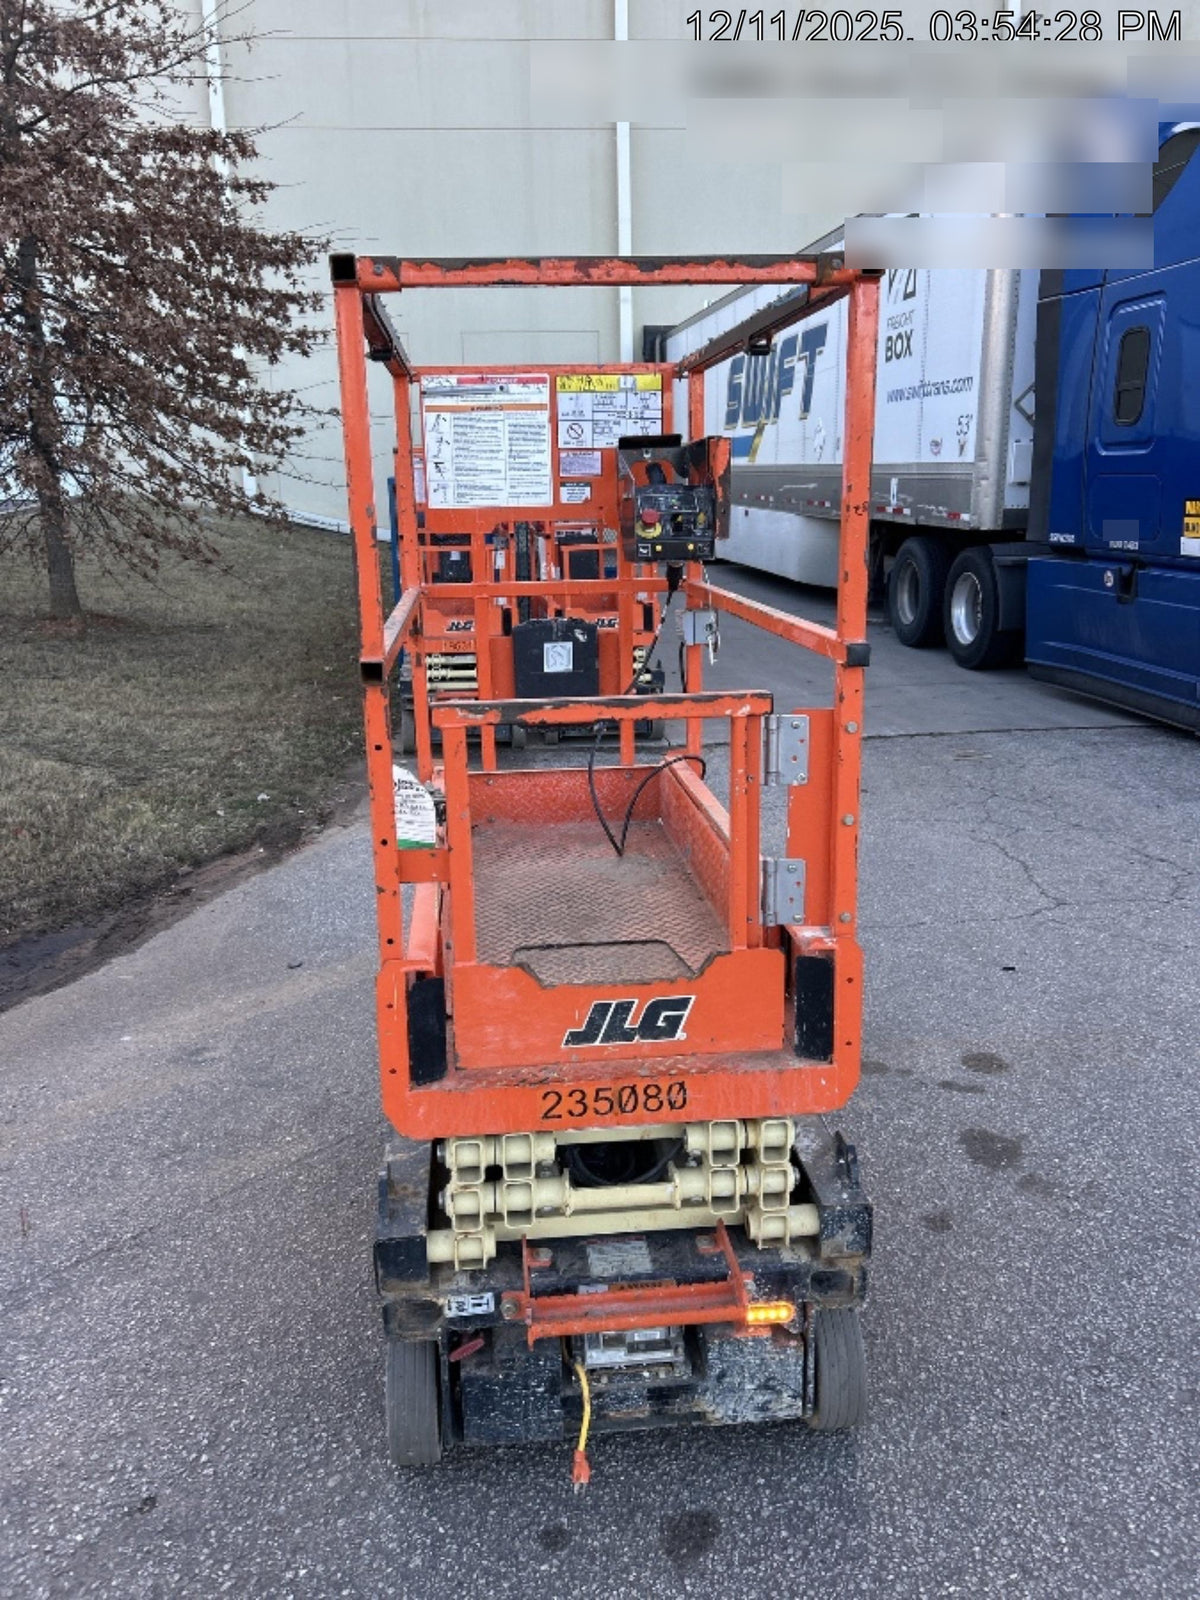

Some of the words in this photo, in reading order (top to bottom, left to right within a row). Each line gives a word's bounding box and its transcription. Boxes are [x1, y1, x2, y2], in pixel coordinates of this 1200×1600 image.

[885, 329, 914, 363] BOX
[723, 321, 829, 431] SWIFT
[562, 996, 695, 1047] JLG
[541, 1081, 687, 1120] 235080
